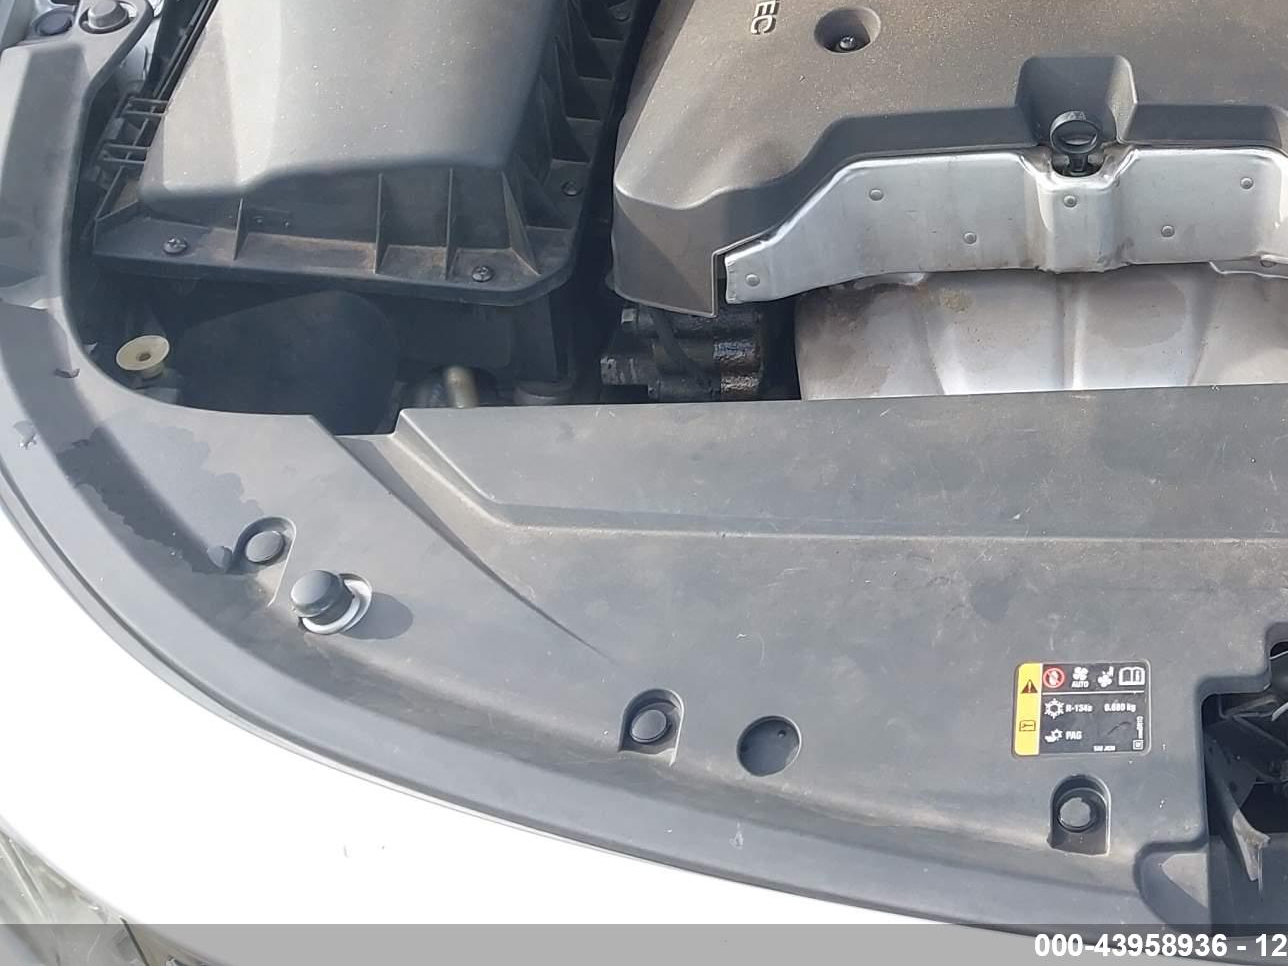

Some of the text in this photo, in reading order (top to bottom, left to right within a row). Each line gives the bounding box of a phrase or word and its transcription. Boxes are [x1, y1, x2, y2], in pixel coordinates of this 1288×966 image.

[1071, 680, 1090, 688] AUTO
[1065, 703, 1093, 713] R-134a
[1126, 702, 1137, 713] kg
[1065, 730, 1083, 740] PAG
